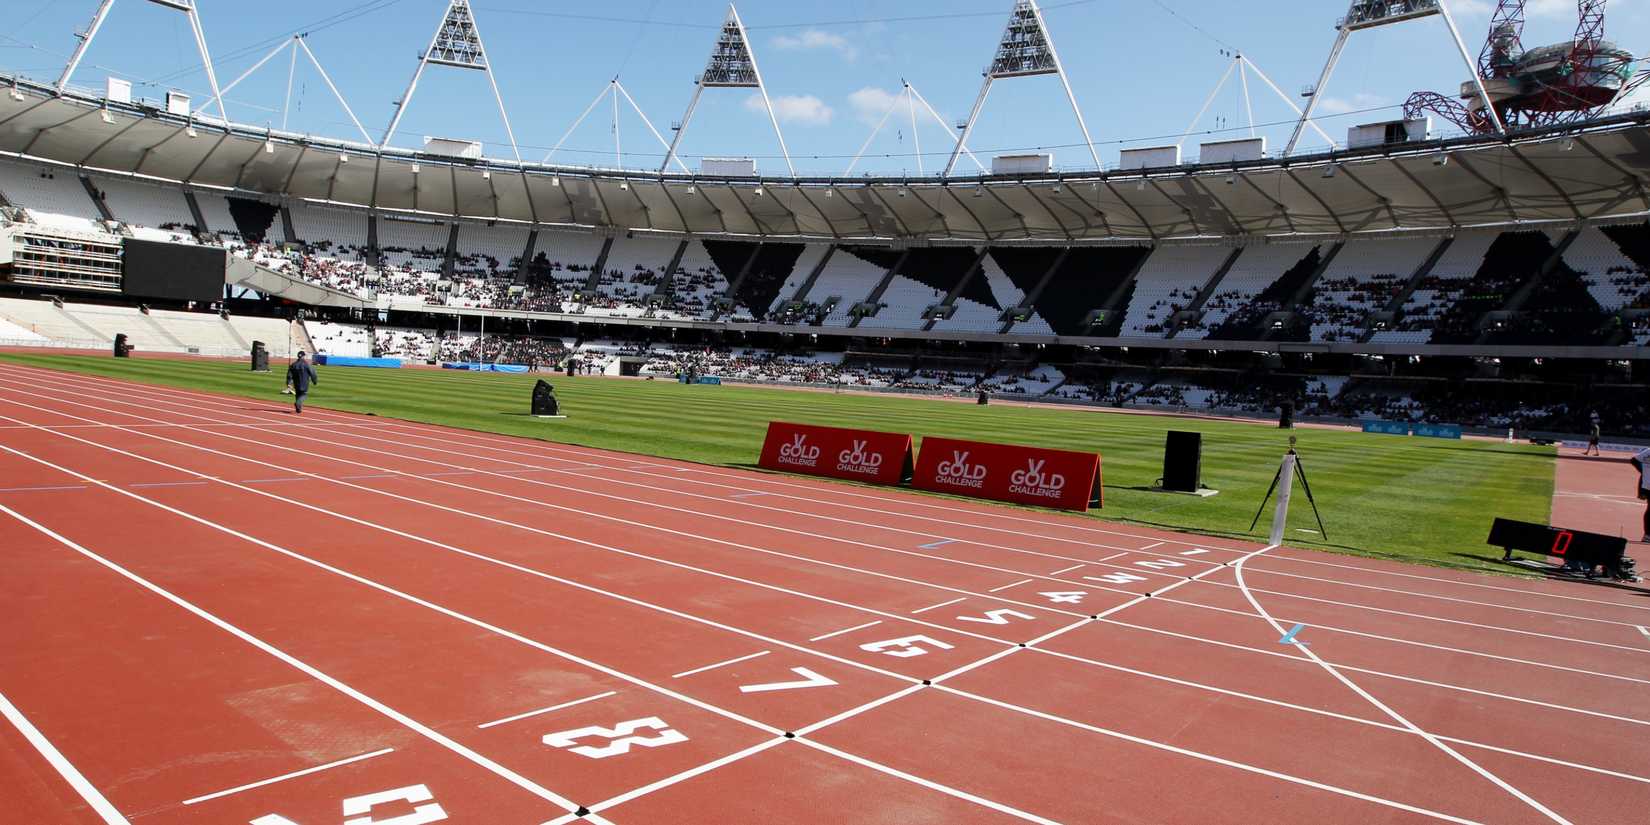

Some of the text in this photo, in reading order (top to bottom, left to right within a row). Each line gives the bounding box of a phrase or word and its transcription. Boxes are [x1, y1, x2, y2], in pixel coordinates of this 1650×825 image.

[780, 442, 820, 459] GOLD
[839, 449, 882, 467] GOLD
[778, 456, 817, 467] CHALLENGE
[837, 463, 878, 474] CHALLENGE
[937, 460, 987, 479] GOLD
[935, 475, 982, 488] CHALLENGE
[1011, 469, 1064, 490] GOLD
[1008, 485, 1061, 498] CHALLENGE
[1552, 531, 1572, 554] 0
[1134, 558, 1186, 569] 2
[1082, 571, 1148, 584] 3
[1038, 591, 1089, 604] 4
[956, 608, 1036, 625] 5
[859, 634, 955, 658] 6
[738, 666, 839, 693] 7
[543, 716, 689, 759] 8
